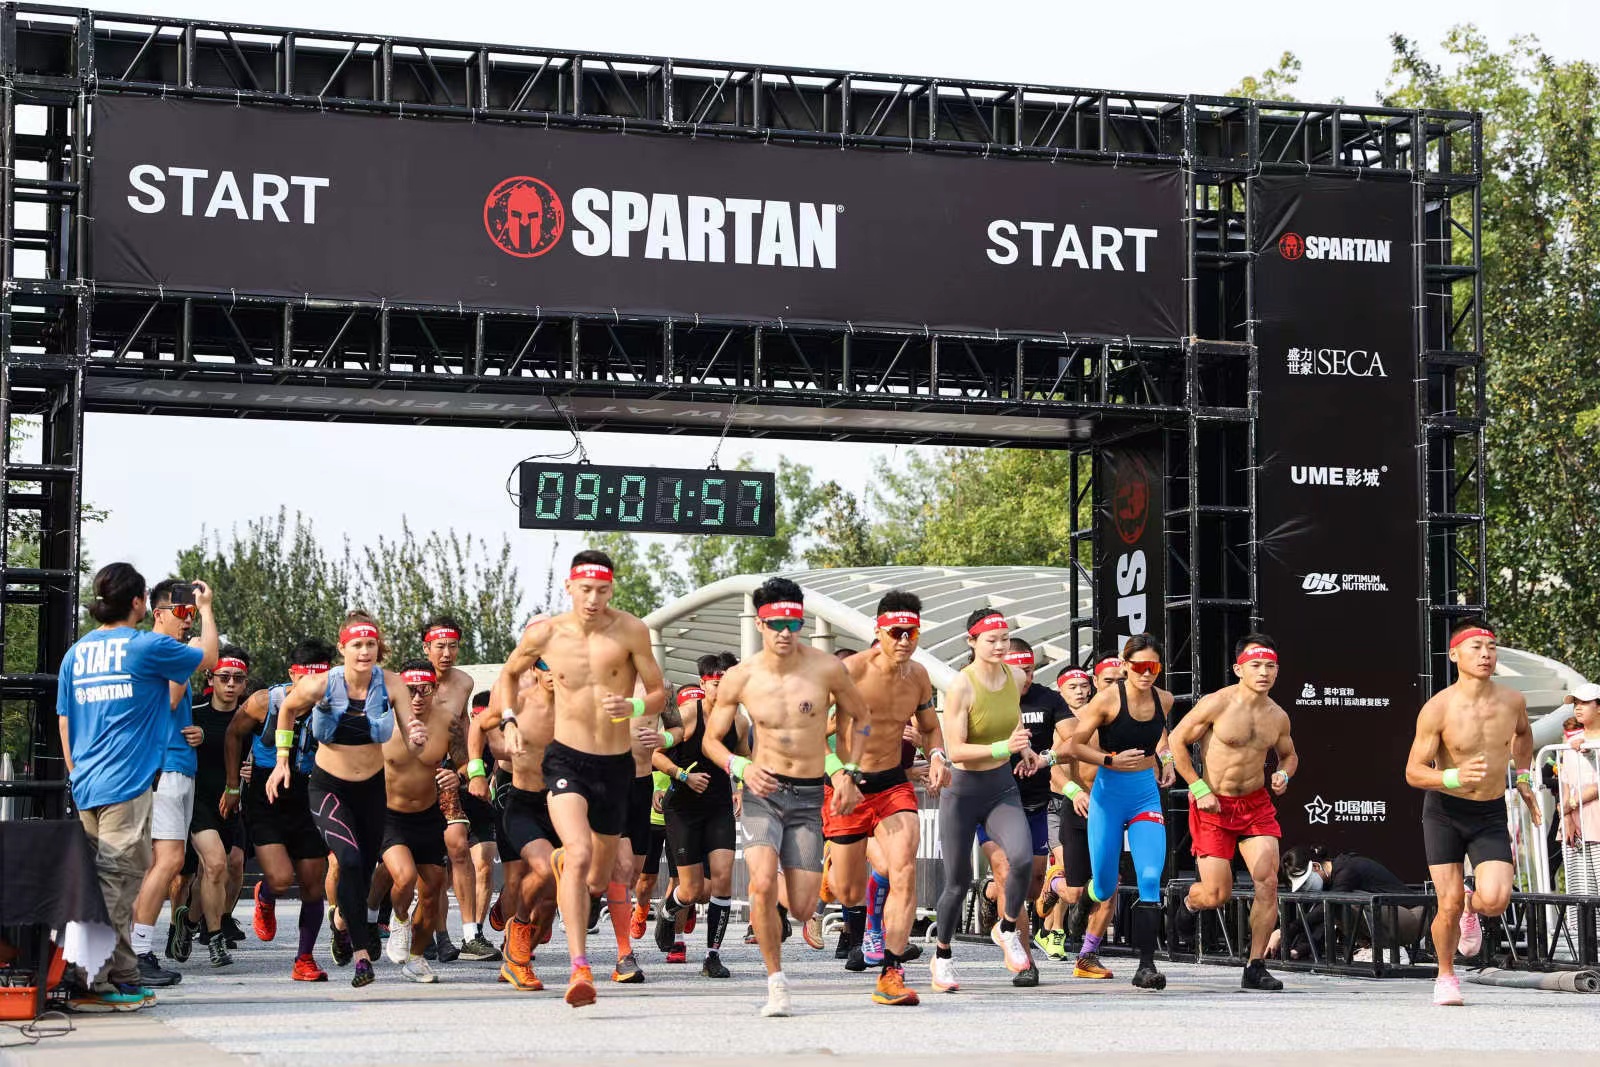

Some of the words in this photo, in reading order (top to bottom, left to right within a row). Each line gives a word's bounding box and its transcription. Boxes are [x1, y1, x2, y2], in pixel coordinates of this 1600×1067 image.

[127, 164, 330, 224] START
[986, 219, 1158, 273] START
[1305, 235, 1391, 263] SPARTAN
[1317, 348, 1388, 377] SECA
[535, 471, 763, 527] 09:01:57
[1342, 574, 1380, 583] OPTIMUM
[73, 637, 130, 677] STAFF
[86, 683, 133, 703] SPARTAN
[1334, 800, 1386, 815] 中国体育
